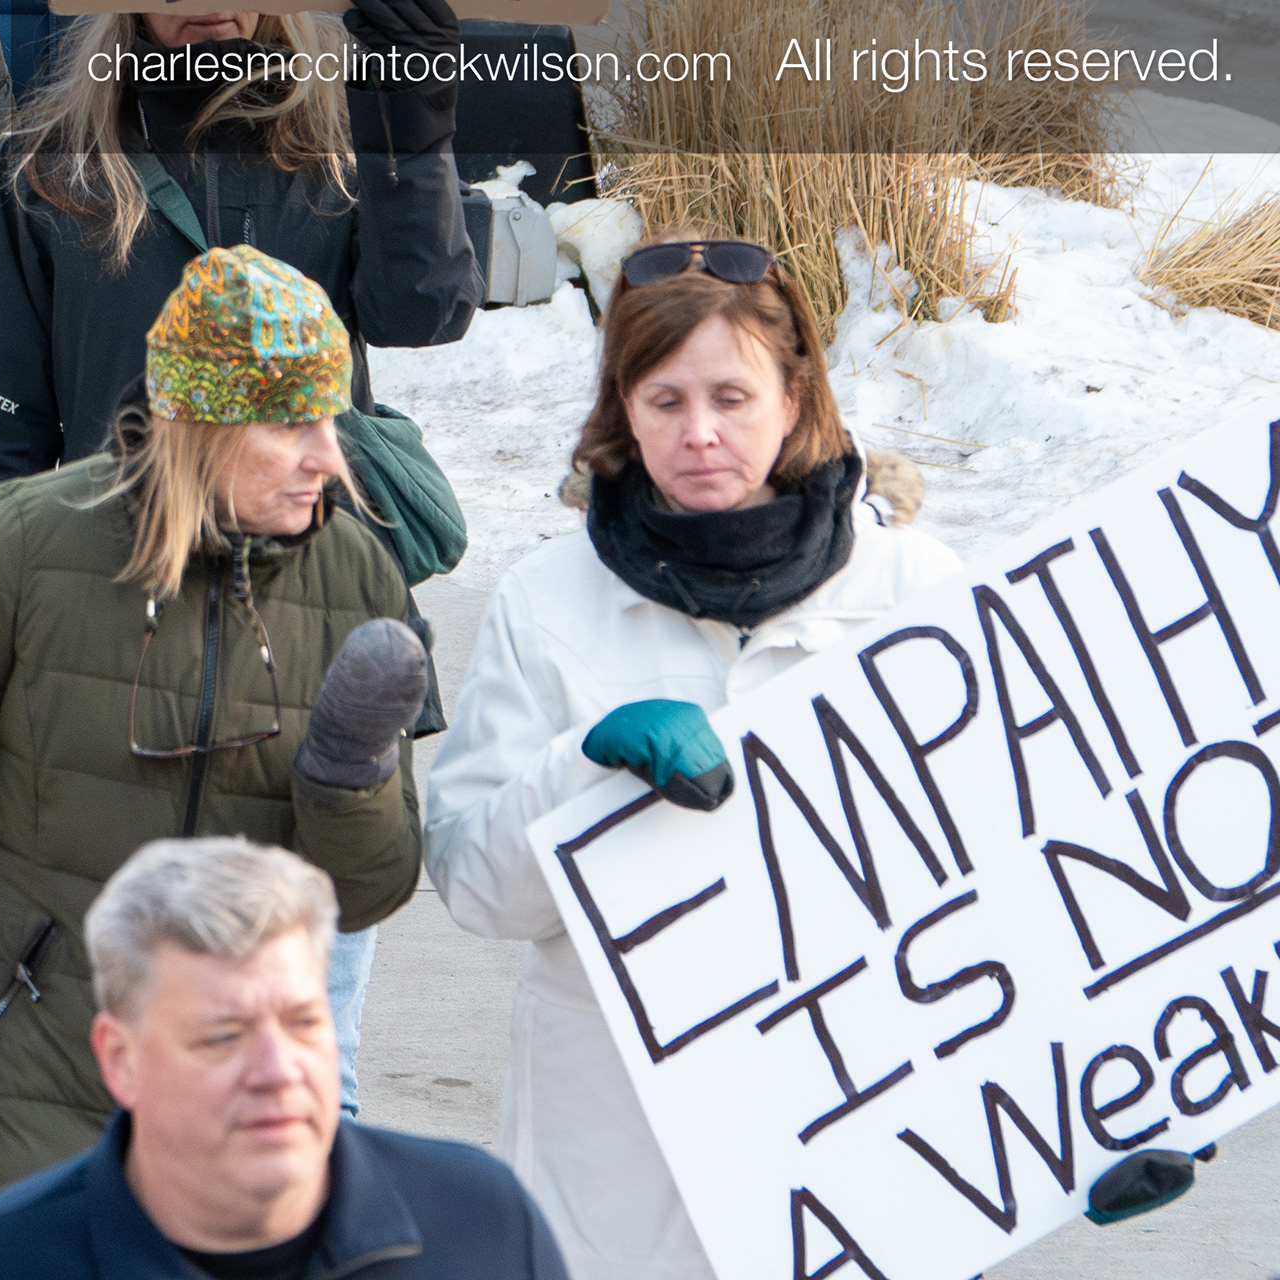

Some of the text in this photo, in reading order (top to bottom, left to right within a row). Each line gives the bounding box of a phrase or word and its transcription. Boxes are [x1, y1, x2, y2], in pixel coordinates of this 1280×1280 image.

[555, 420, 1280, 1065] EMPATHY
[755, 706, 1280, 1147] IS NO
[896, 937, 1280, 1234] Weak
